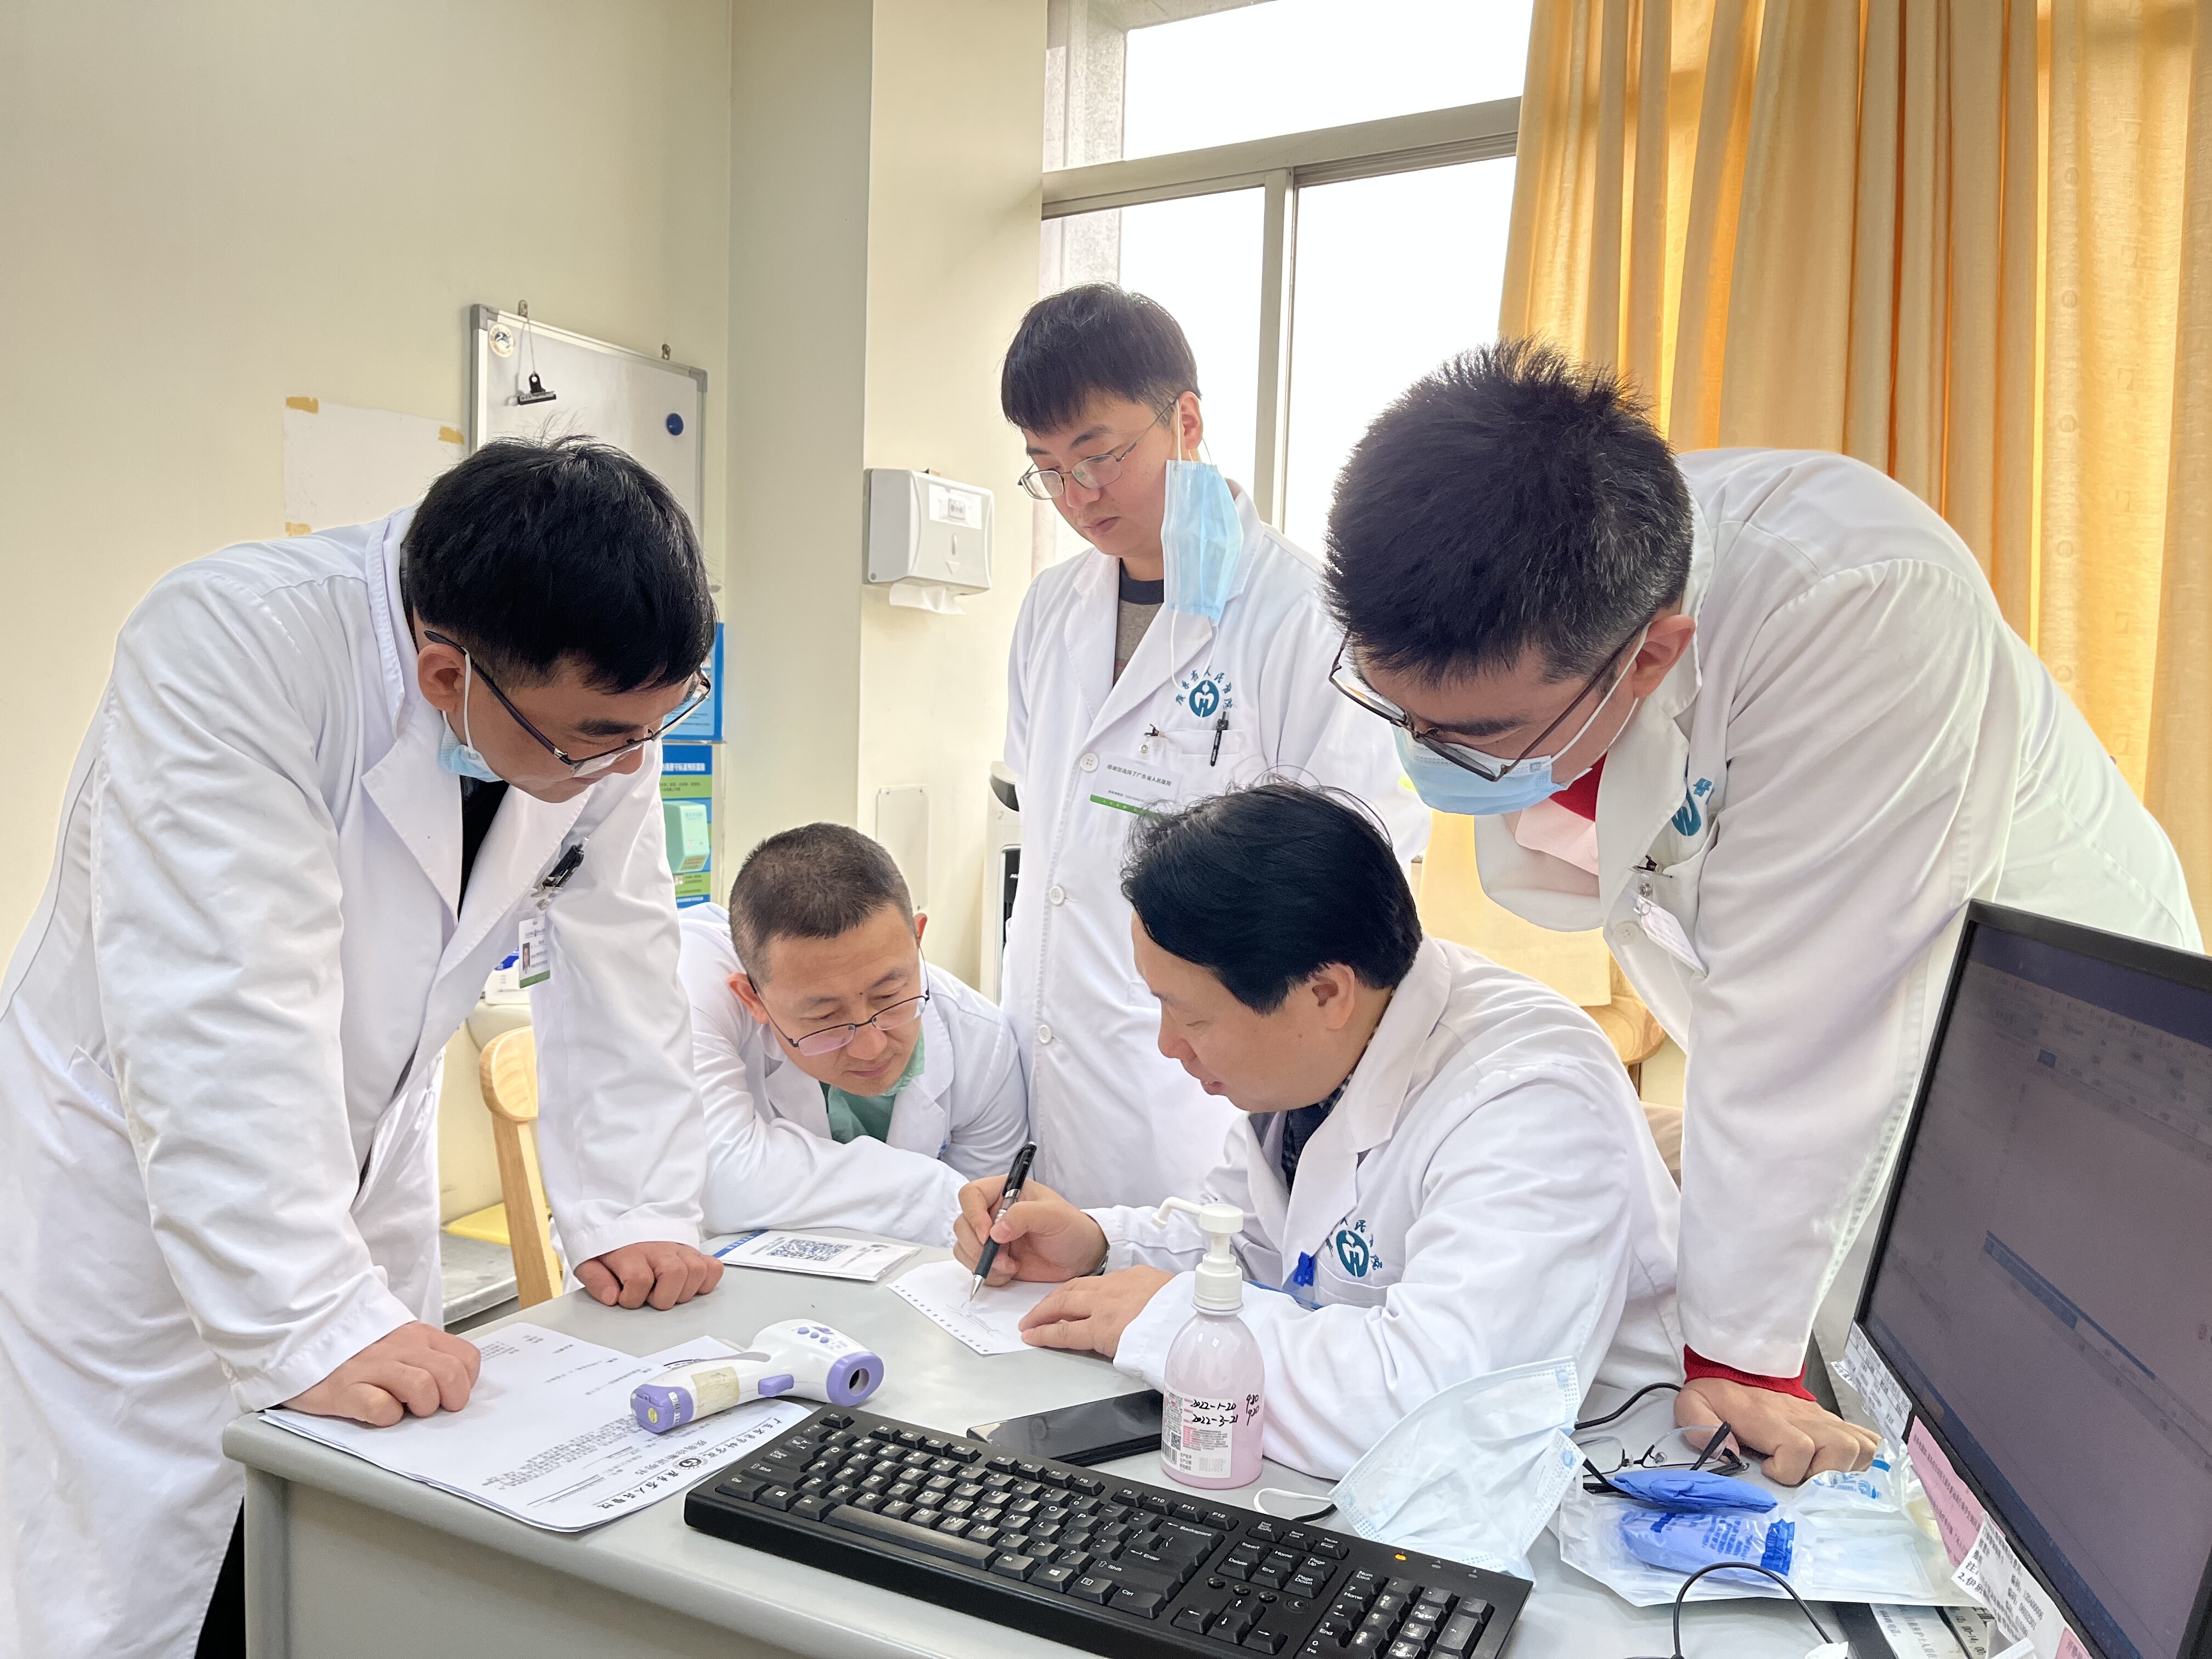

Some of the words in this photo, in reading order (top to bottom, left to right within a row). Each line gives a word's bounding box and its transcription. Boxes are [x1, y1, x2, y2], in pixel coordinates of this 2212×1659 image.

[1180, 1526, 1212, 1537] Backspace
[1242, 1542, 1260, 1550] Insert
[1143, 1553, 1160, 1561] Enter
[1228, 1558, 1248, 1566] Delete
[1344, 1592, 1363, 1600] Home
